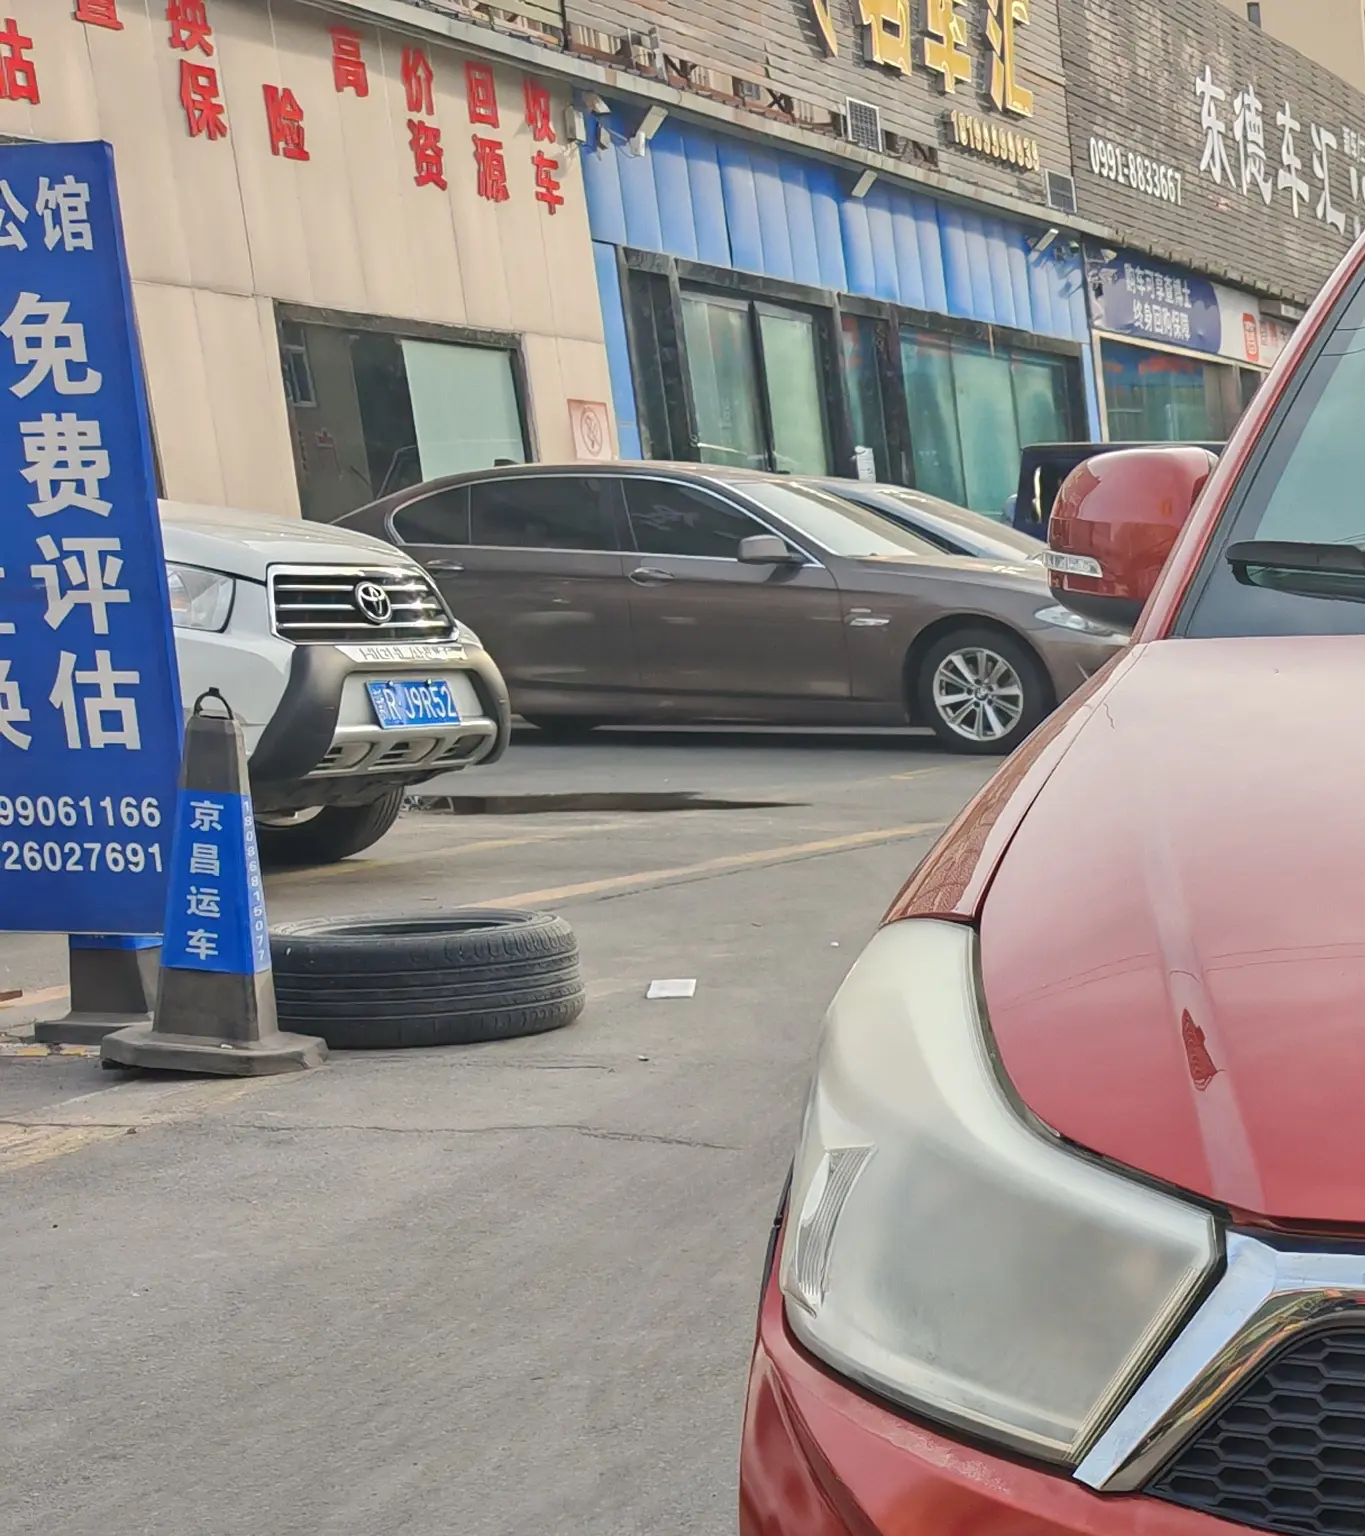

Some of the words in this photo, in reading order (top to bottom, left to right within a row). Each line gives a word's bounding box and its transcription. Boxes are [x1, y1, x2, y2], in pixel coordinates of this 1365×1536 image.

[179, 59, 310, 161] 保险
[406, 118, 565, 215] 资源车
[327, 24, 556, 143] 高价回收
[1090, 136, 1182, 206] 0991-8833667
[0, 291, 141, 750] 免费评估
[0, 796, 161, 828] 99061166
[185, 799, 224, 961] 京昌运车
[243, 799, 266, 960] 18086815077
